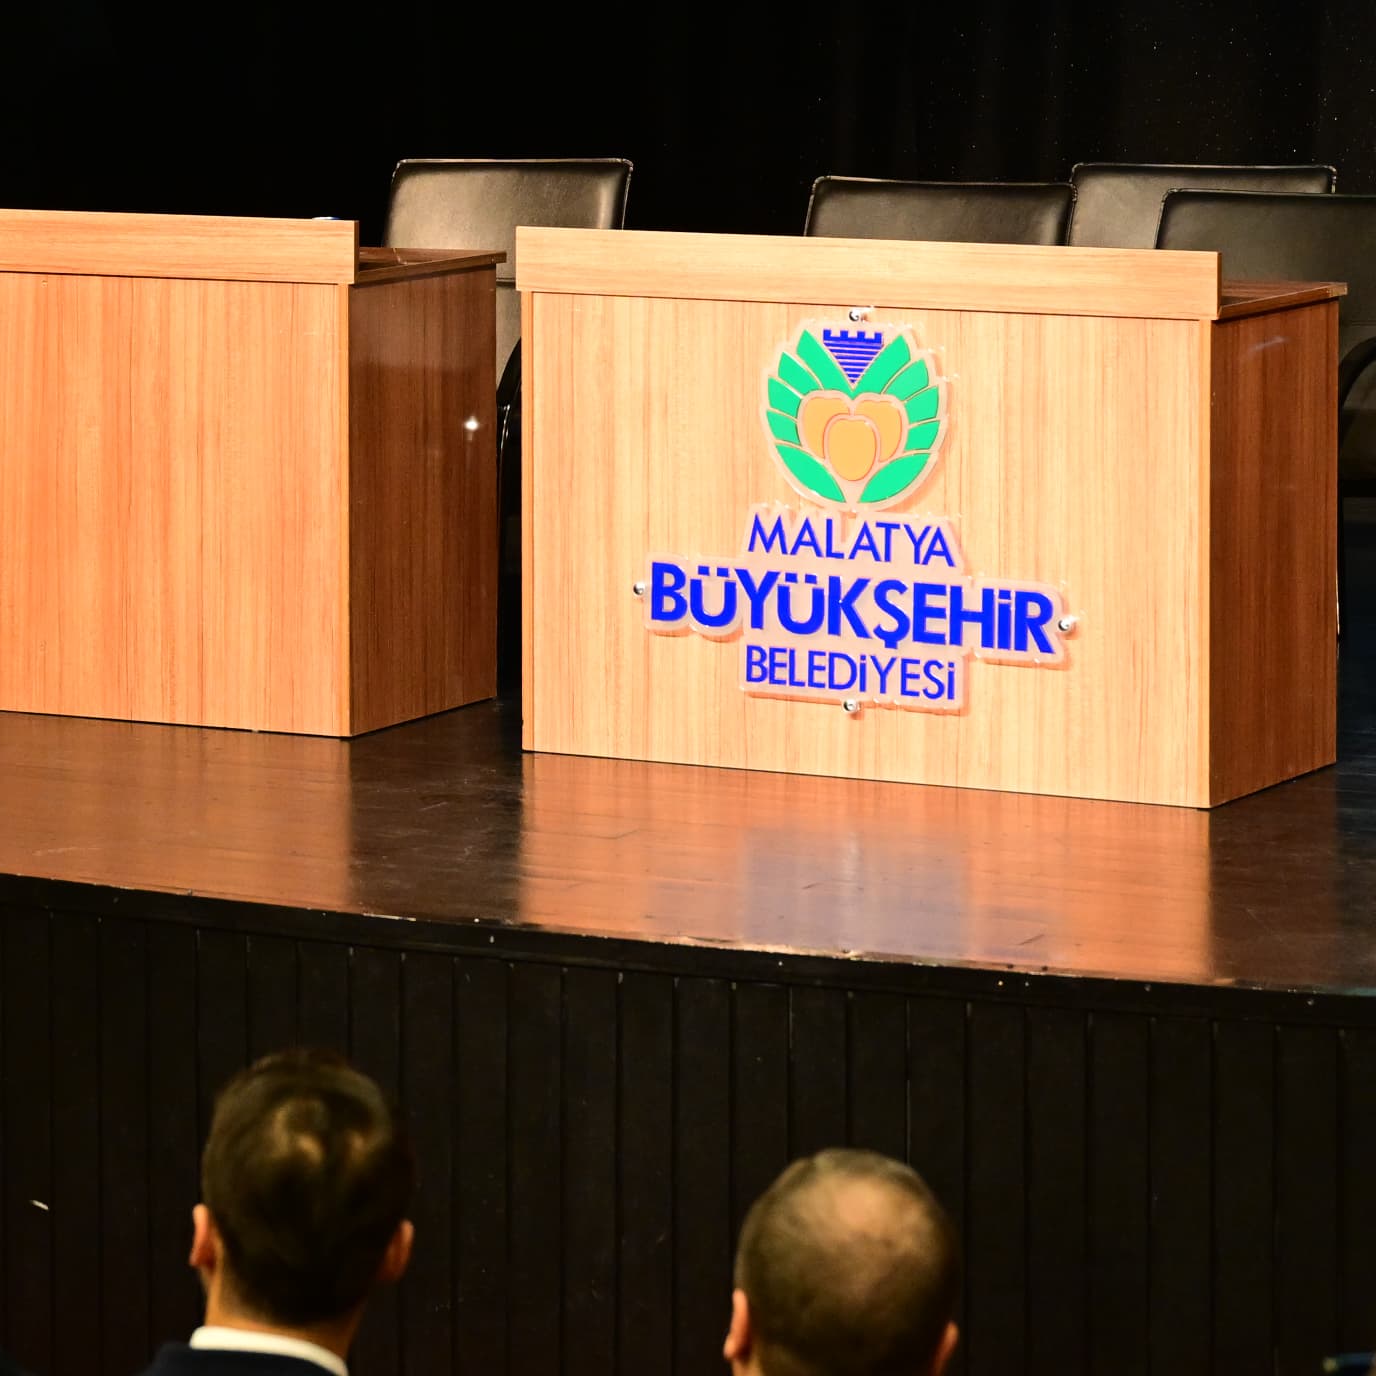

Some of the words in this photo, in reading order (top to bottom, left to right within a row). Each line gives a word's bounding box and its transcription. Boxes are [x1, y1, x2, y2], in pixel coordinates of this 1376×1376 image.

[747, 513, 957, 568] MALATYA
[650, 560, 1057, 655] BÜYÜKŞEHİR
[745, 643, 956, 701] BELEDİYESİ
